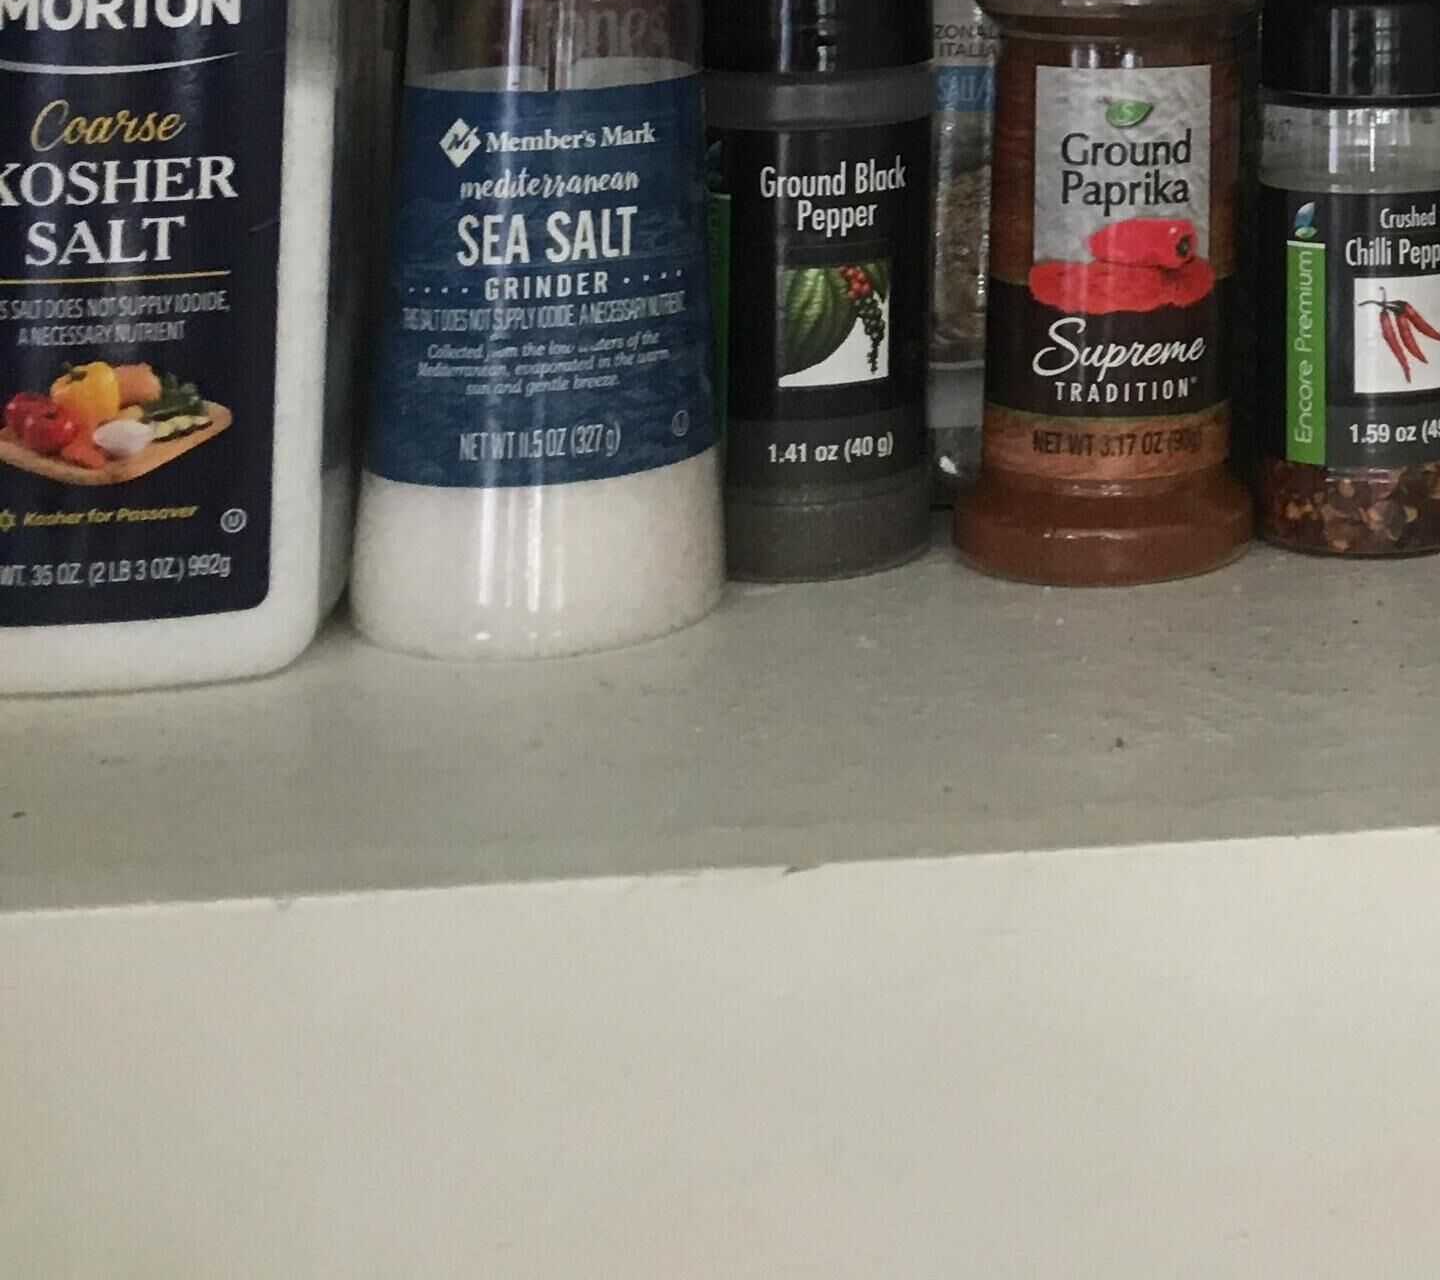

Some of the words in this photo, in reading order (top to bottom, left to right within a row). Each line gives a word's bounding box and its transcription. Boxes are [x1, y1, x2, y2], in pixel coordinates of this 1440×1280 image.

[30, 100, 187, 152] Coarse
[486, 130, 596, 153] Member's
[601, 121, 656, 147] Mark
[1061, 128, 1192, 166] Ground
[460, 167, 640, 200] mediterranean
[760, 161, 846, 198] Ground
[855, 155, 906, 195] Black
[1061, 169, 1190, 217] Paprika
[797, 199, 878, 238] Pepper
[1380, 204, 1436, 229] Crushed
[25, 216, 186, 266] SALT
[456, 213, 531, 267] SEA
[545, 206, 638, 263] SALT
[1345, 237, 1391, 266] Chilli
[484, 271, 608, 301] GRINDER
[1295, 250, 1314, 352] Premium
[45, 298, 83, 319] DOES
[87, 297, 117, 317] NOT
[1032, 317, 1206, 382] Supreme
[1295, 359, 1314, 443] Encore
[460, 432, 488, 460] NET
[490, 431, 515, 459] WT
[546, 428, 567, 456] OZ
[768, 443, 807, 463] 1.41
[815, 443, 839, 462] oz
[844, 436, 873, 463] (40
[1142, 431, 1162, 454] OZ
[1350, 423, 1390, 444] 1.59
[1396, 425, 1416, 443] oz
[109, 559, 130, 582] LB
[135, 559, 147, 581] 3
